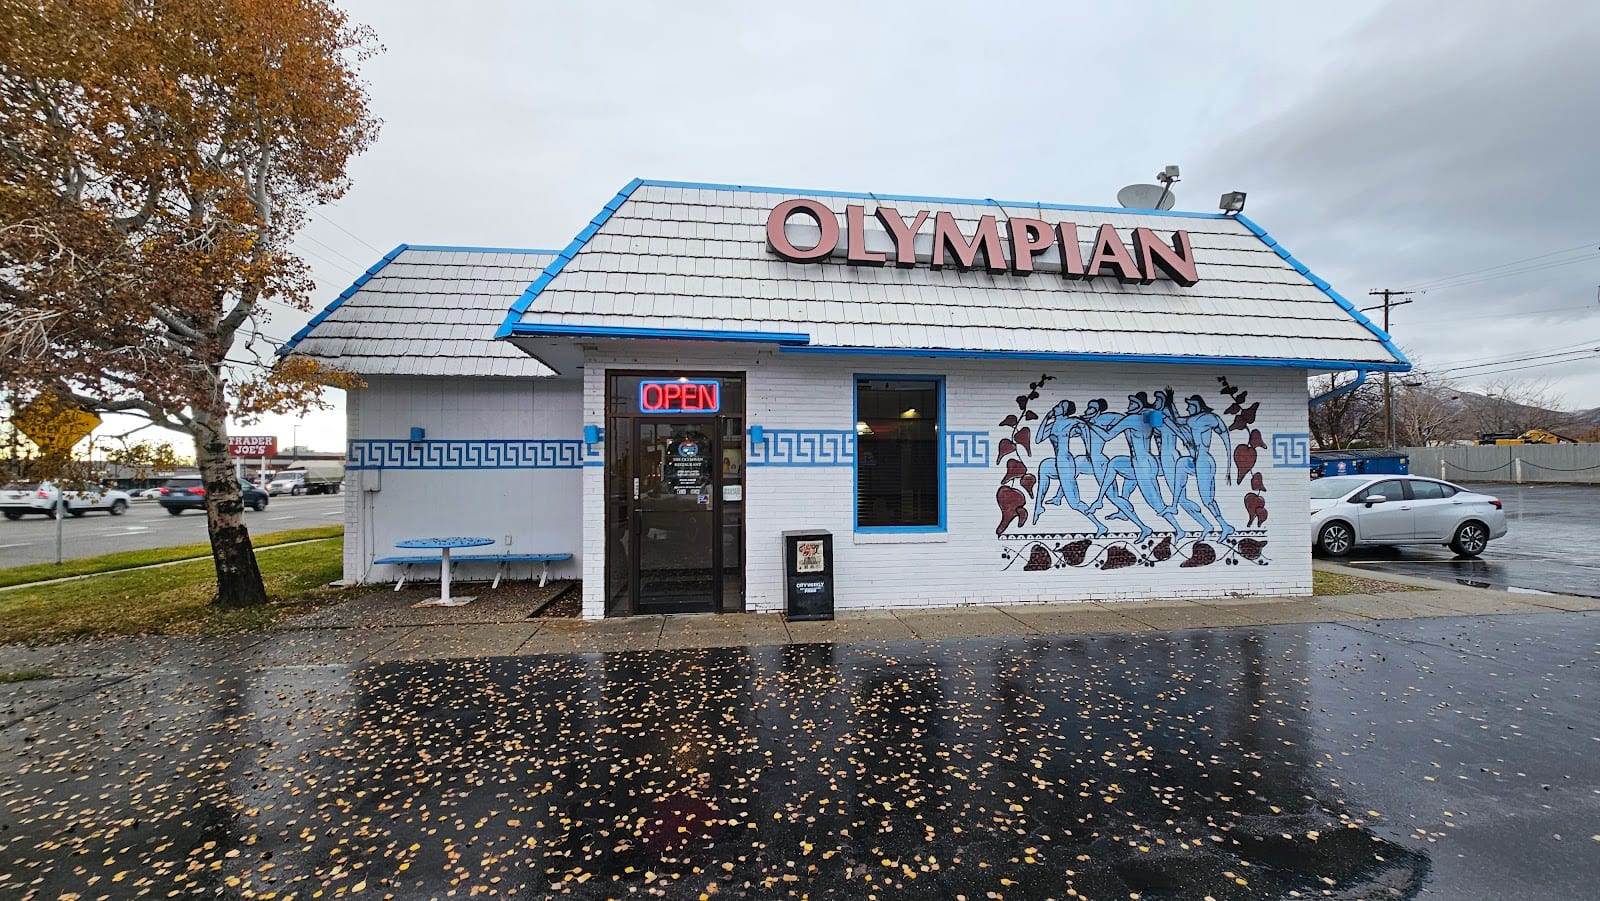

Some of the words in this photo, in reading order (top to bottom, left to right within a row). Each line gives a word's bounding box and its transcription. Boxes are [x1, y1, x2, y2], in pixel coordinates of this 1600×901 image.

[766, 199, 1199, 287] OLYMPIAN
[643, 384, 717, 410] OPEN
[228, 436, 272, 445] TRADER
[234, 445, 265, 454] JOE'S
